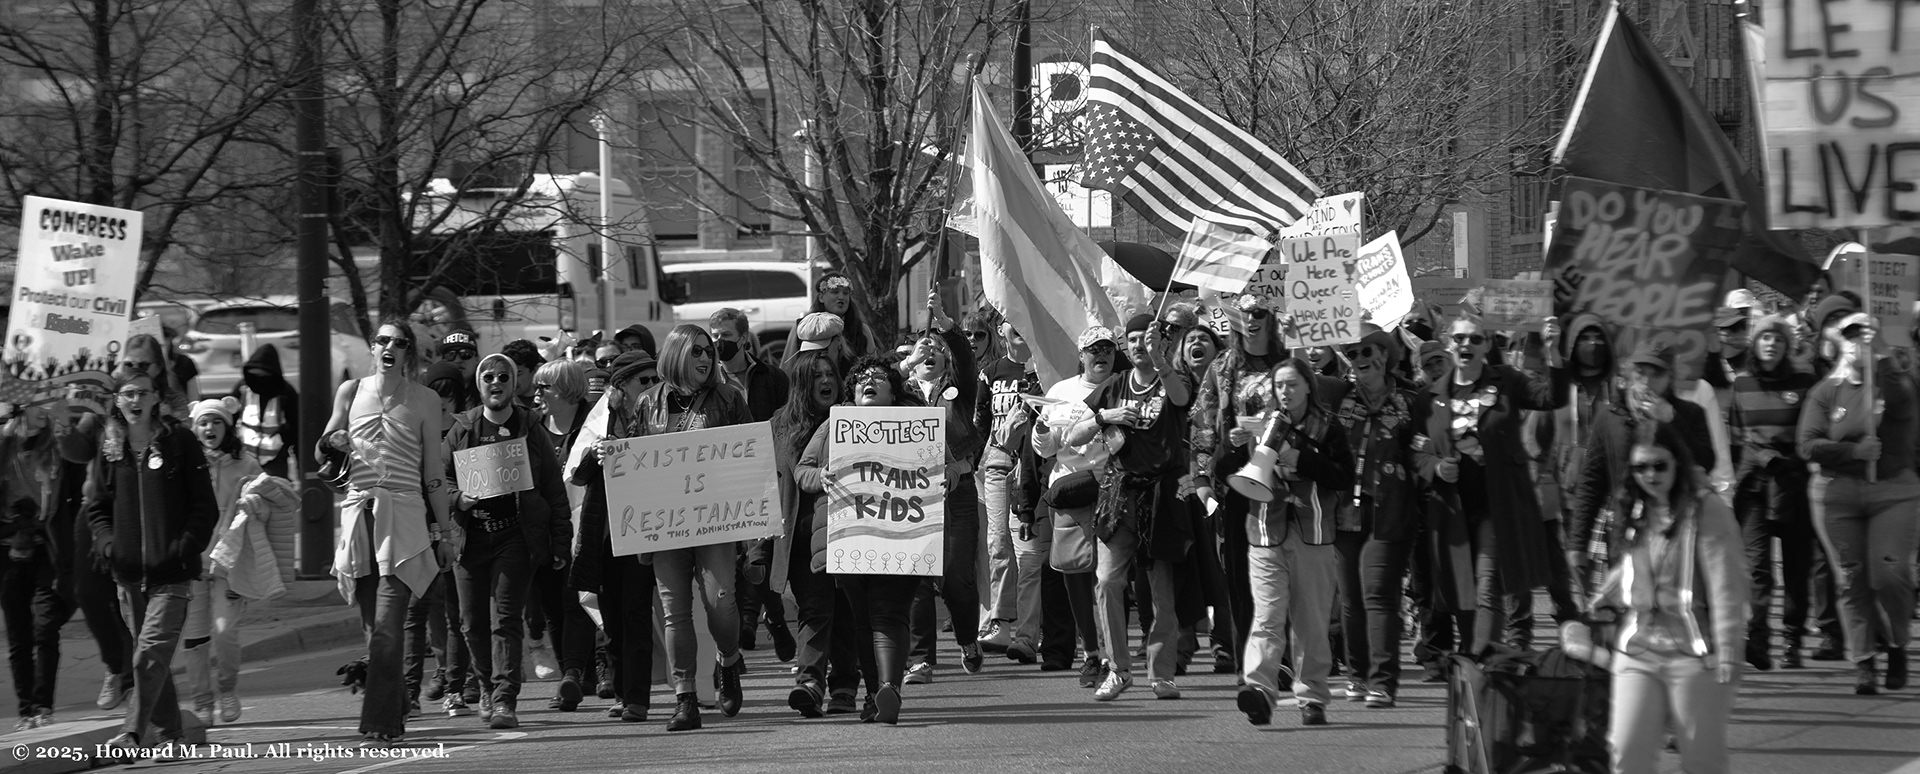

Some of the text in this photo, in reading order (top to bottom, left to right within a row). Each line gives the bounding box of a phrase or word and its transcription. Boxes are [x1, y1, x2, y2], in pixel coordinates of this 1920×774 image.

[1784, 0, 1920, 59] LET
[1810, 64, 1899, 129] US
[1783, 141, 1920, 221] LIVE
[40, 208, 127, 240] CONGRESS
[1307, 207, 1336, 226] KIND
[1571, 190, 1705, 235] DO YOU
[50, 242, 105, 262] Wake
[1292, 237, 1353, 263] We Are
[1357, 246, 1392, 275] TRANS
[1575, 221, 1690, 279] HEAR
[63, 268, 96, 287] UP!
[1307, 265, 1338, 279] Here
[1359, 258, 1394, 284] RIGHTS
[19, 286, 127, 315] Protect our Civil
[1292, 280, 1339, 301] Queer
[1571, 272, 1716, 327] PEOPLE
[1294, 308, 1328, 322] HAVE
[1333, 305, 1354, 318] NO
[1296, 320, 1353, 346] FEAR
[992, 379, 1018, 394] BLA
[836, 418, 940, 445] PROTECT
[453, 443, 524, 467] WE CAN SEE
[607, 441, 631, 456] OUR
[611, 438, 757, 478] EXISTENCE
[461, 466, 520, 492] YOU TOO
[684, 473, 706, 494] IS
[853, 461, 930, 491] TRANS
[621, 497, 770, 537] RESISTANCE
[645, 519, 768, 542] TO THIS ADMINISTRATION
